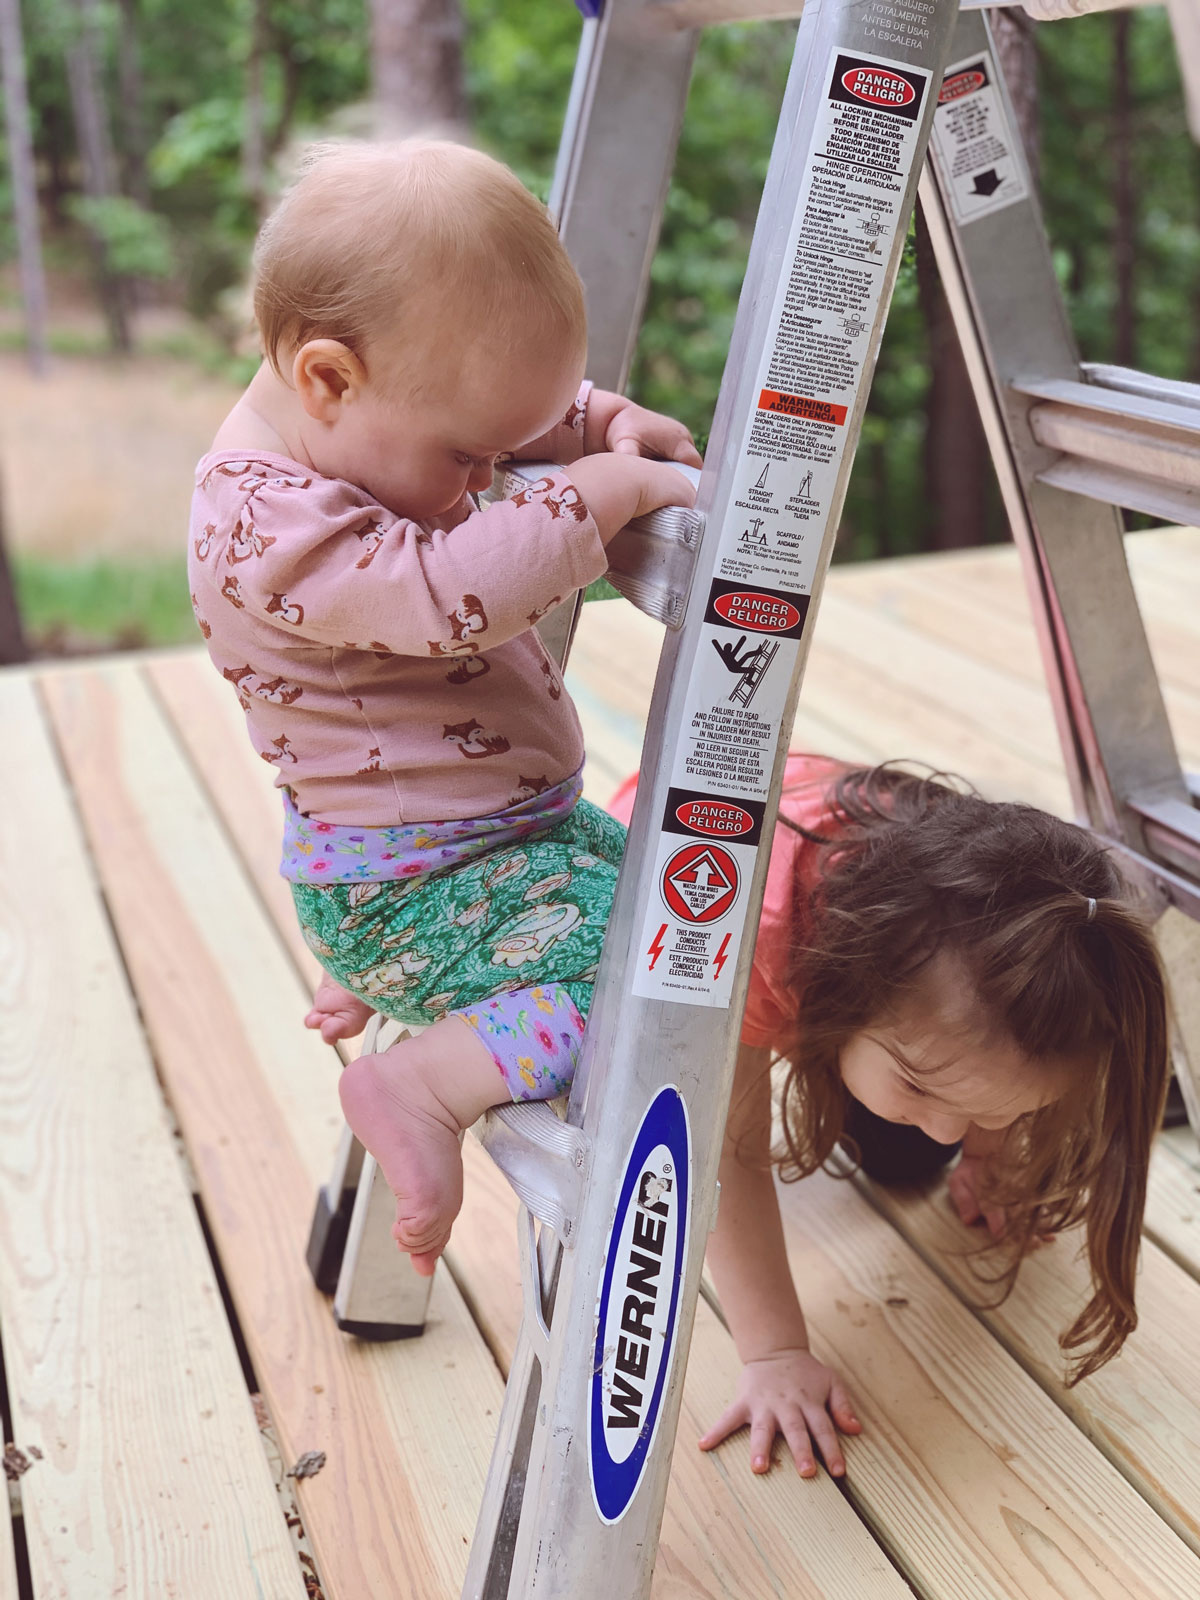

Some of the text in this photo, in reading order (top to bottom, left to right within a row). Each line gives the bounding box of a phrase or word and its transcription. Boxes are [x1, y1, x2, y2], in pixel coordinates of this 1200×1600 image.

[871, 2, 927, 25] TOTALMENTE
[861, 13, 929, 39] ANTES DE USAR
[864, 27, 922, 49] LA ESCALERA
[857, 71, 907, 92] DANGER
[852, 82, 903, 104] PELIGRO
[830, 102, 913, 128] ALL LOCKING MECHANISMS
[842, 112, 860, 122] MUST
[871, 119, 900, 132] ENGAGED
[833, 118, 904, 141] BEFORE USING LADDER
[835, 127, 900, 149] TODO MECANISMO DE
[826, 141, 870, 156] ENGANCHADO
[871, 152, 891, 161] ANTES
[830, 133, 900, 156] SUJECIÓN DEBE ESTAR
[826, 148, 896, 170] UTILIZAR LA ESCALERA
[812, 165, 846, 179] OPERACIÓN
[846, 173, 854, 181] DE
[863, 178, 901, 192] ARTICULACIÓN
[826, 160, 893, 182] HINGE OPERATION
[832, 181, 846, 189] Hinge
[806, 205, 817, 213] Para
[820, 255, 833, 263] Hinge
[769, 402, 835, 423] ADVERTENCIA
[780, 395, 831, 413] WARNING
[767, 413, 791, 423] LADDERS
[792, 418, 805, 426] ONLY
[811, 422, 835, 432] POSITIONS
[750, 436, 780, 447] POSICIONES
[751, 430, 771, 438] UTILICE
[779, 436, 805, 446] ESCALERA
[748, 488, 773, 498] STRAIGHT
[749, 495, 770, 504] LADDER
[735, 501, 762, 511] ESCALERA
[785, 505, 809, 514] ESCALERA
[776, 531, 801, 540] SCAFFOLD
[732, 596, 788, 615] DANGER
[728, 608, 787, 629] PELIGRO
[694, 712, 771, 731] AND FOLLOW INSTRUCTIONS
[712, 706, 759, 721] FAILURE TO READ
[702, 722, 714, 730] THIS
[715, 724, 738, 734] LADDER
[751, 730, 771, 739] RESULT
[707, 731, 732, 742] INJURIES
[742, 737, 760, 746] DEATH.
[693, 751, 738, 764] INSTRUCCIONES
[747, 759, 759, 767] ESTA
[696, 742, 705, 750] NO
[706, 744, 721, 752] LEER
[729, 747, 749, 757] SEGUIR
[749, 751, 760, 759] LAS
[686, 757, 764, 776] ESCALERA PODRÍA RESULTAR
[686, 766, 694, 774] EN
[696, 768, 723, 778] LESIONES
[737, 775, 759, 784] MUERTE.
[692, 805, 745, 821] DANGER
[689, 816, 742, 833] PELIGRO
[679, 936, 705, 946] CONDUCTS
[688, 931, 711, 939] PRODUCT
[675, 943, 707, 953] ELECTRICITY
[669, 954, 708, 966] ESTE PRODUCTO
[672, 962, 696, 971] CONDUCE
[669, 968, 703, 979] ELECTRICIDAD
